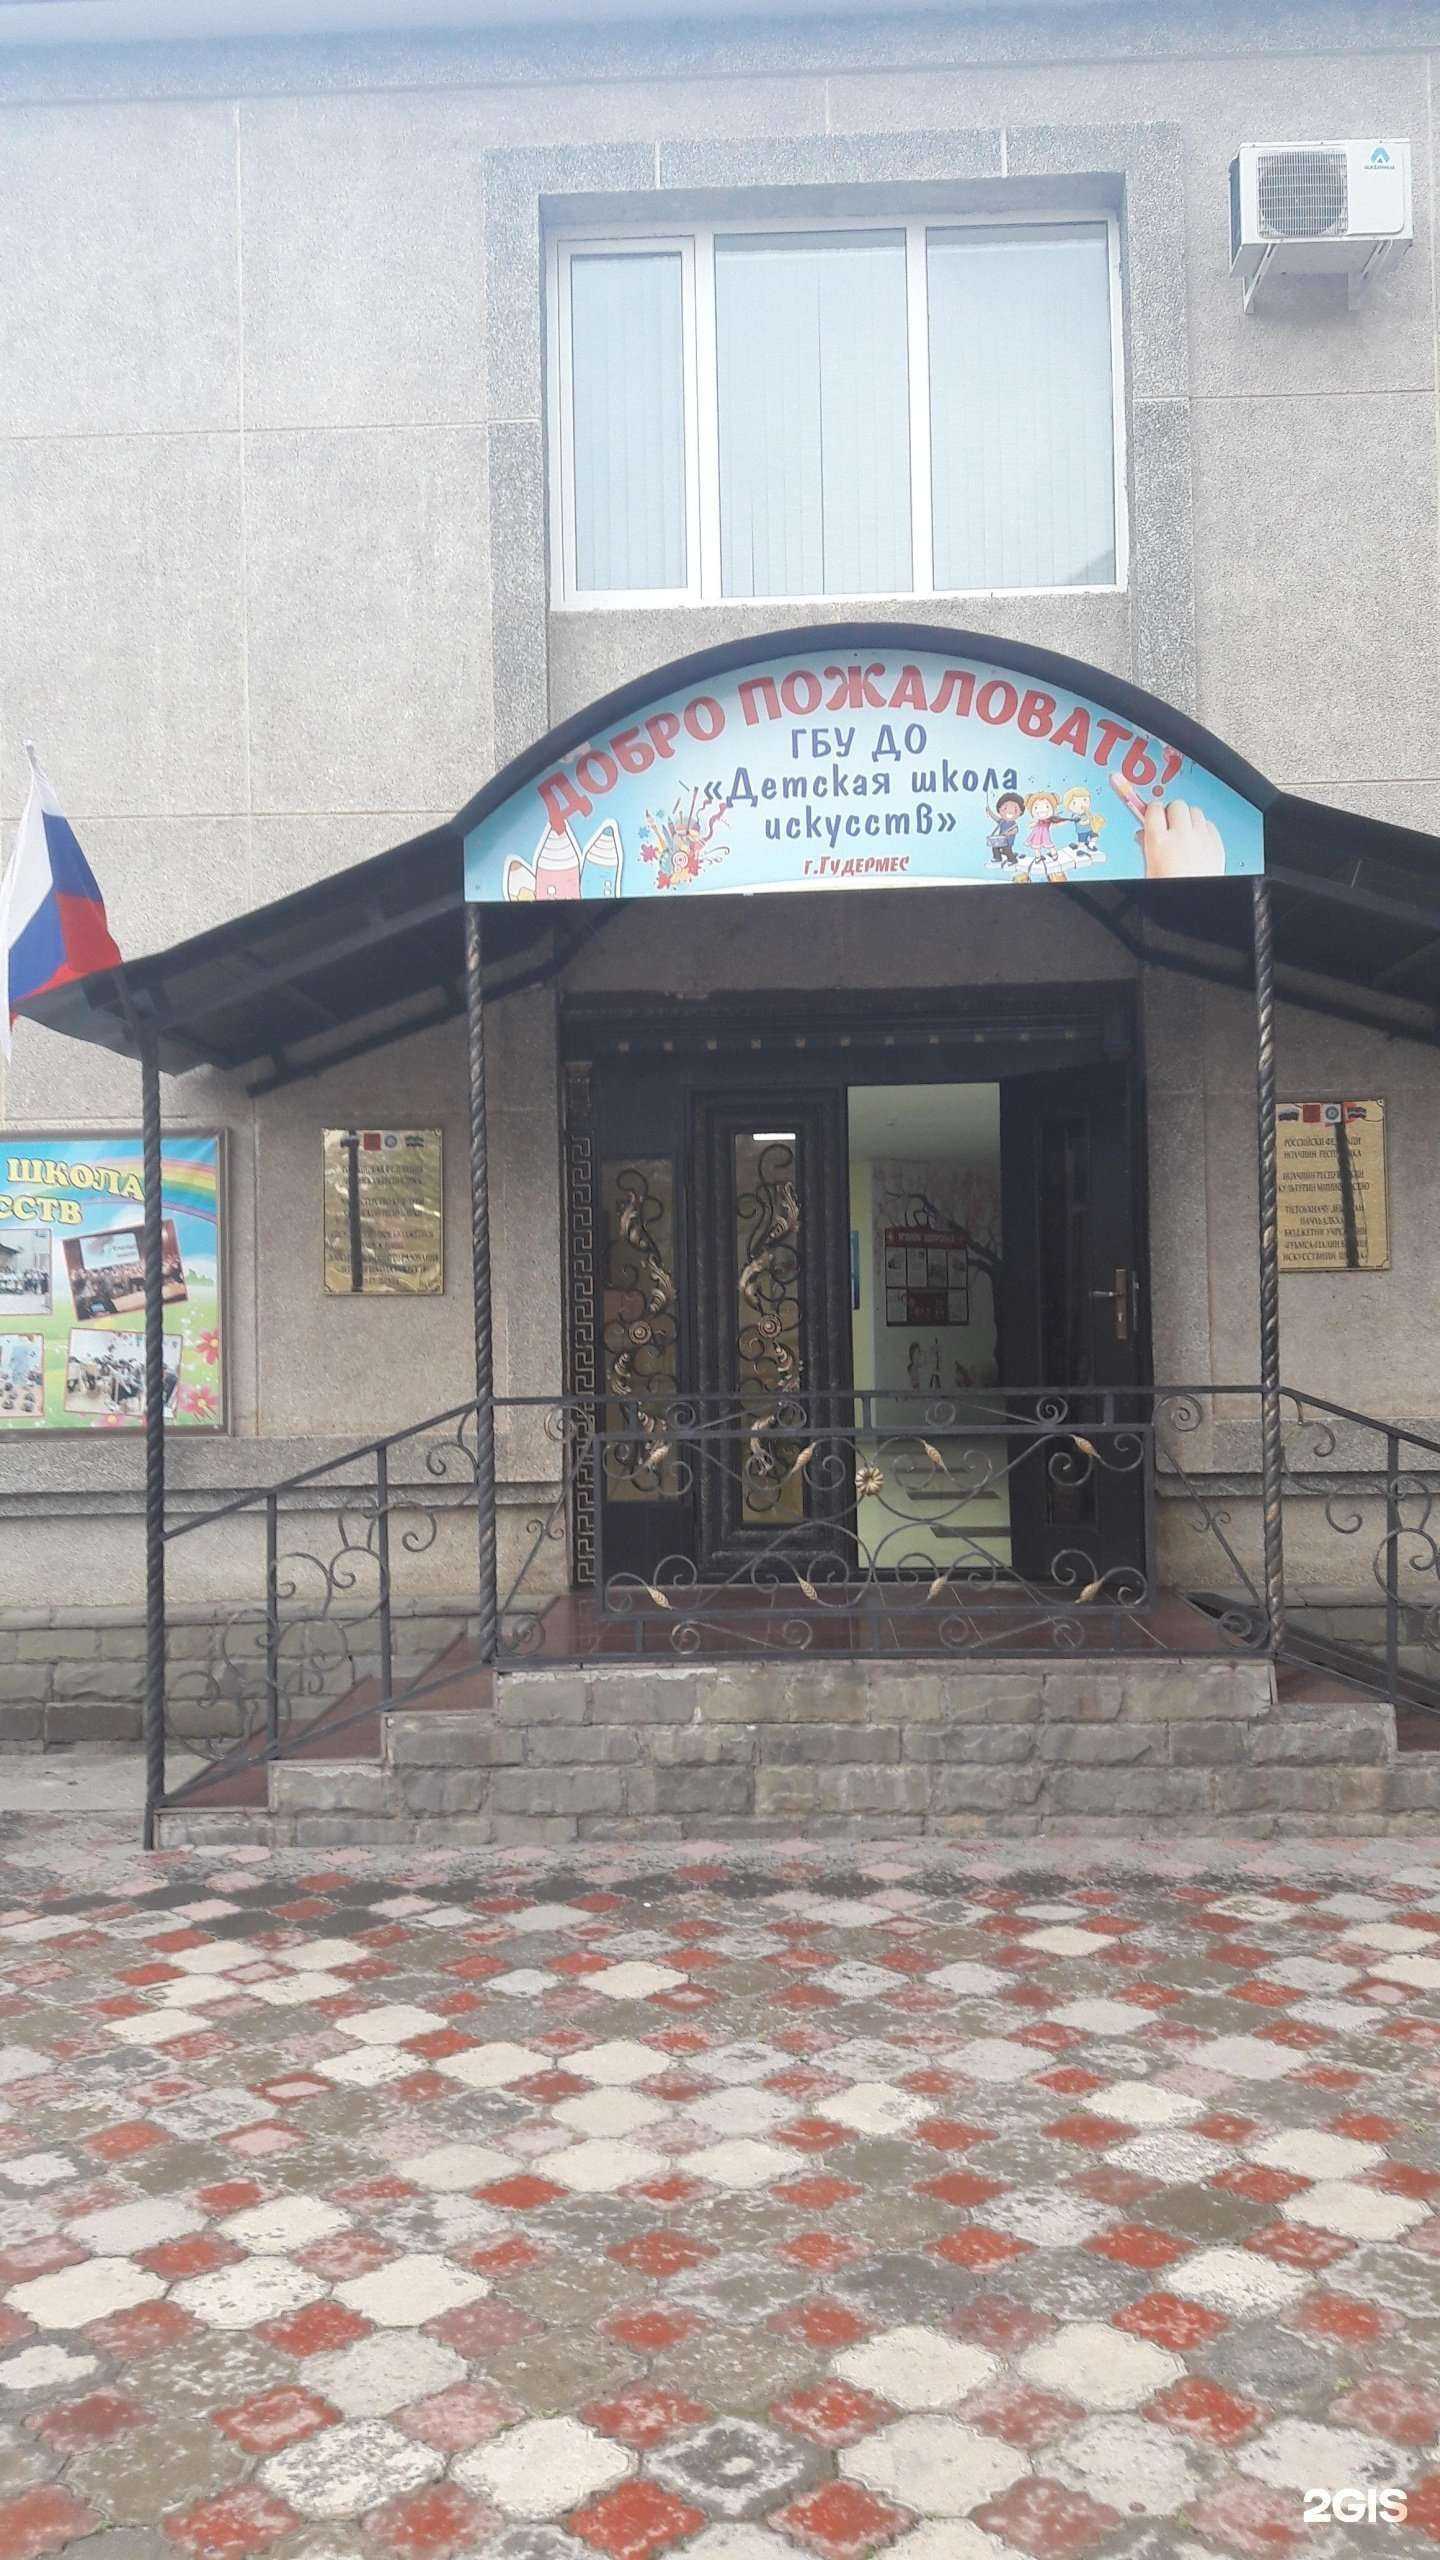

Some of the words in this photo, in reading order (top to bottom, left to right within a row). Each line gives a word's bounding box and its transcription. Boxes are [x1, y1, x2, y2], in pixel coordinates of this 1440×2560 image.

[537, 695, 726, 837] ДОБРО
[737, 662, 1183, 798] ПОЖАЛОВАТЬ!
[791, 726, 856, 760] ГБУ
[871, 722, 928, 763] ДО
[703, 763, 890, 808] «Детская
[911, 758, 1018, 794] школа
[765, 801, 957, 849] искусств»
[7, 1157, 146, 1202] ШКОЛА
